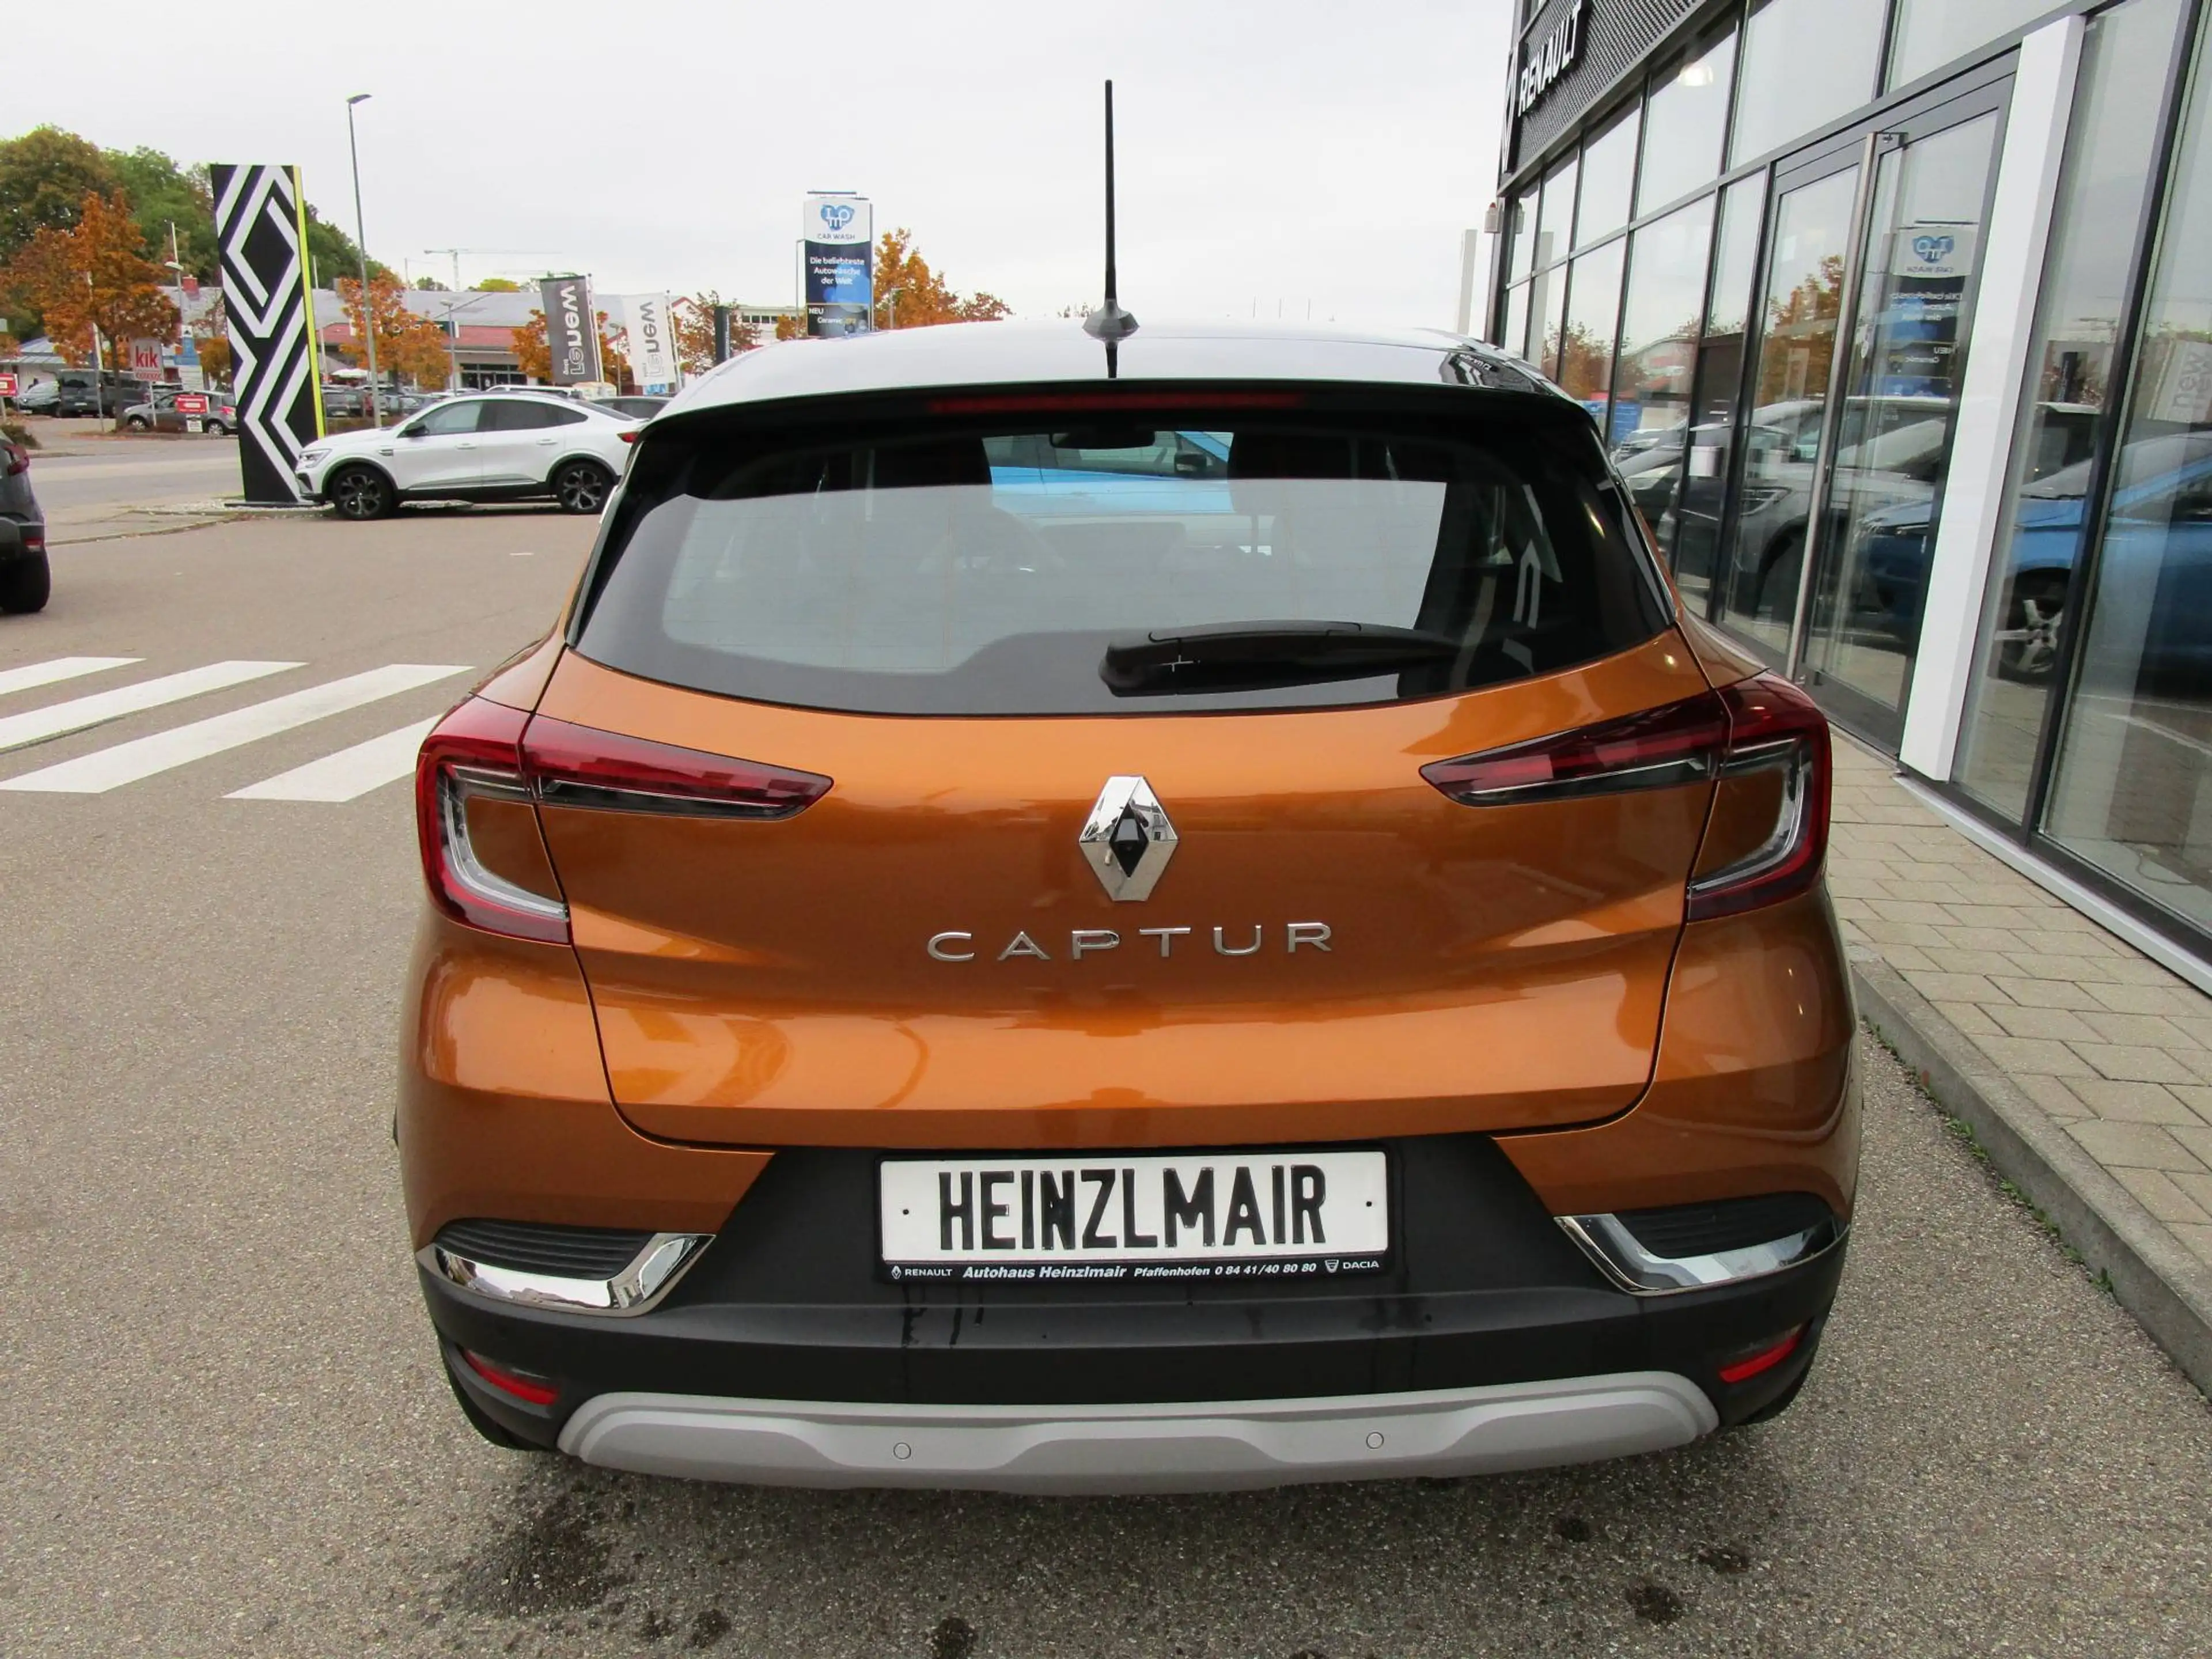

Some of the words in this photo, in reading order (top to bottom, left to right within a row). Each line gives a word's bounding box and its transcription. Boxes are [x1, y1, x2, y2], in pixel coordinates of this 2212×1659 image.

[1518, 0, 1582, 117] RENAULT
[823, 257, 865, 265] beliebteste
[927, 923, 1332, 962] CAPTUR
[939, 1164, 1327, 1251] HEINZLMAIR
[905, 1268, 952, 1277] RENAULT
[963, 1266, 1036, 1279] Autohaus
[1039, 1265, 1127, 1278] Heinzlmair
[1134, 1266, 1211, 1277] Pfaffenhofen
[1215, 1266, 1223, 1275] 0
[1225, 1266, 1240, 1275] 84
[1243, 1264, 1280, 1275] 41/40
[1283, 1263, 1298, 1274] 80
[1301, 1263, 1317, 1272] 80
[1343, 1259, 1380, 1270] DACIA
